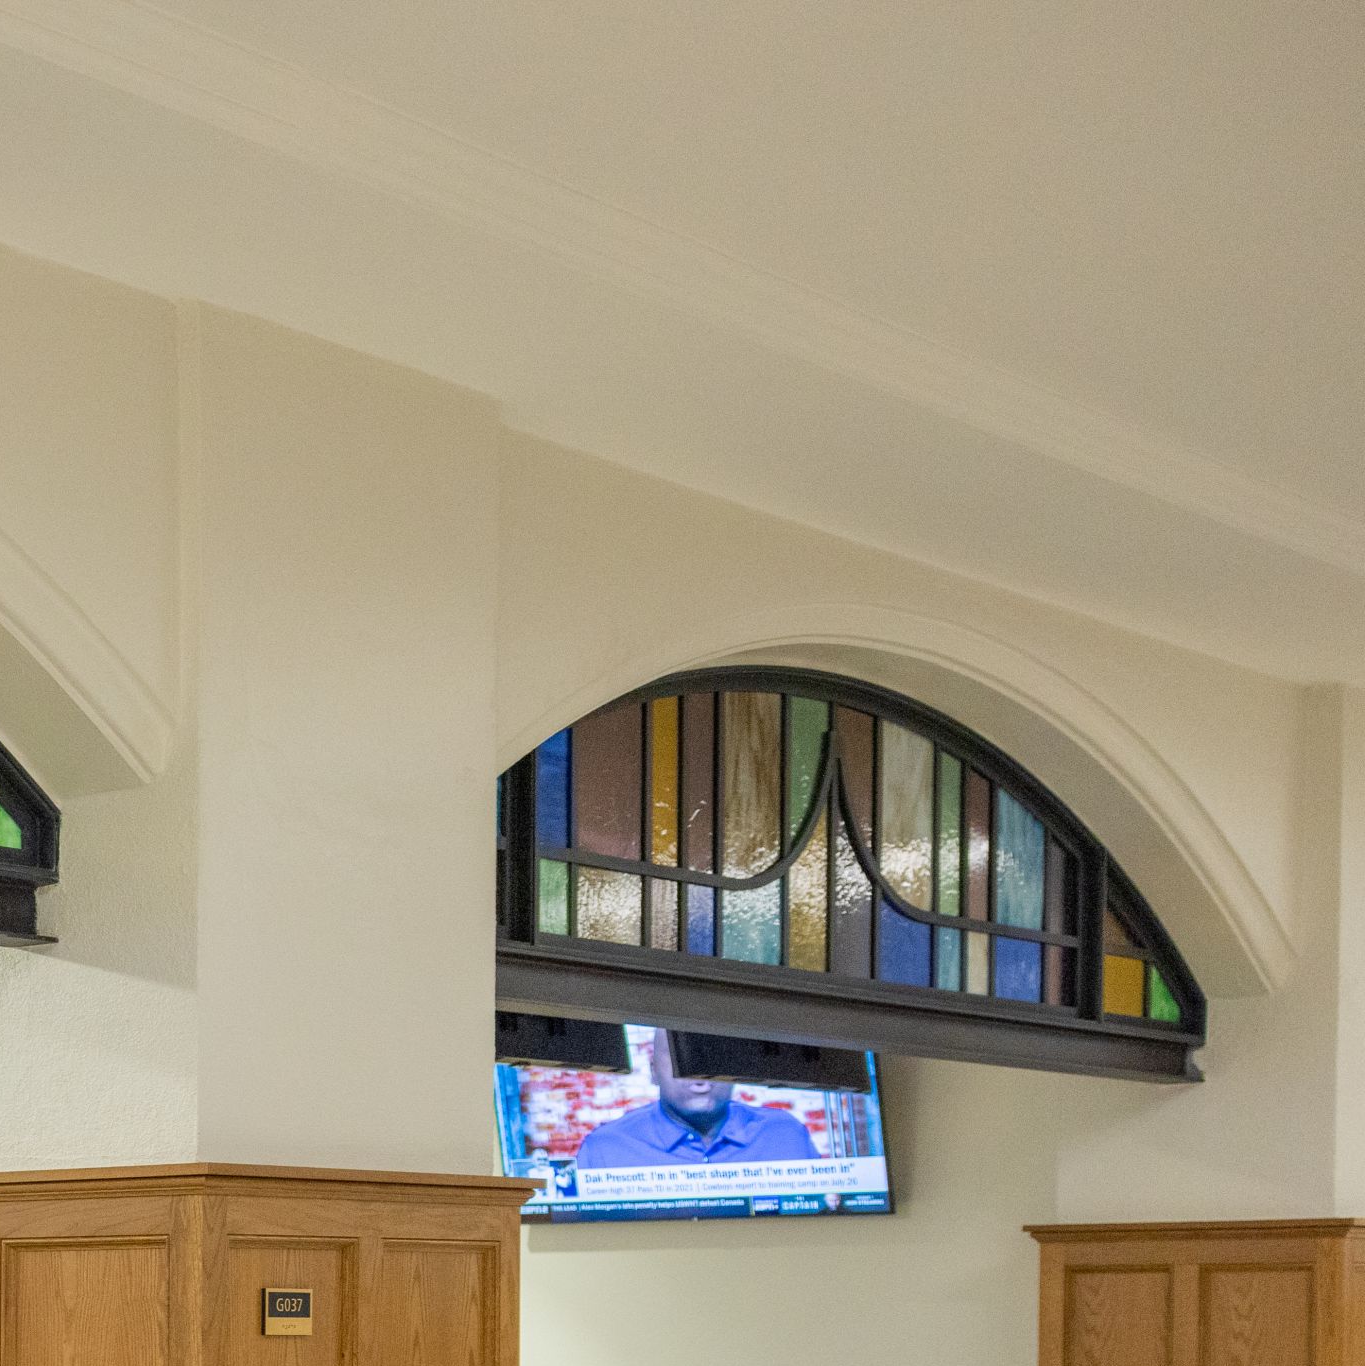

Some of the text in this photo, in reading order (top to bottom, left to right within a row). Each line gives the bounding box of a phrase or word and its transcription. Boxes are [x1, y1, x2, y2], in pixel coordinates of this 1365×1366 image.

[584, 1173, 602, 1184] Dak
[651, 1170, 666, 1181] I'm
[669, 1170, 678, 1180] in
[680, 1169, 707, 1180] "best
[710, 1168, 739, 1180] shape
[742, 1167, 763, 1177] that
[766, 1166, 783, 1176] I've
[787, 1166, 807, 1176] ever
[811, 1164, 837, 1175] been
[840, 1162, 855, 1174] in"
[674, 1184, 693, 1192] 2021
[703, 1183, 733, 1191] Cowboys
[735, 1182, 755, 1190] report
[768, 1181, 795, 1189] training
[797, 1180, 818, 1188] camp
[832, 1179, 845, 1188] July
[782, 1201, 819, 1210] CAPTAIN
[276, 1297, 303, 1312] G037
